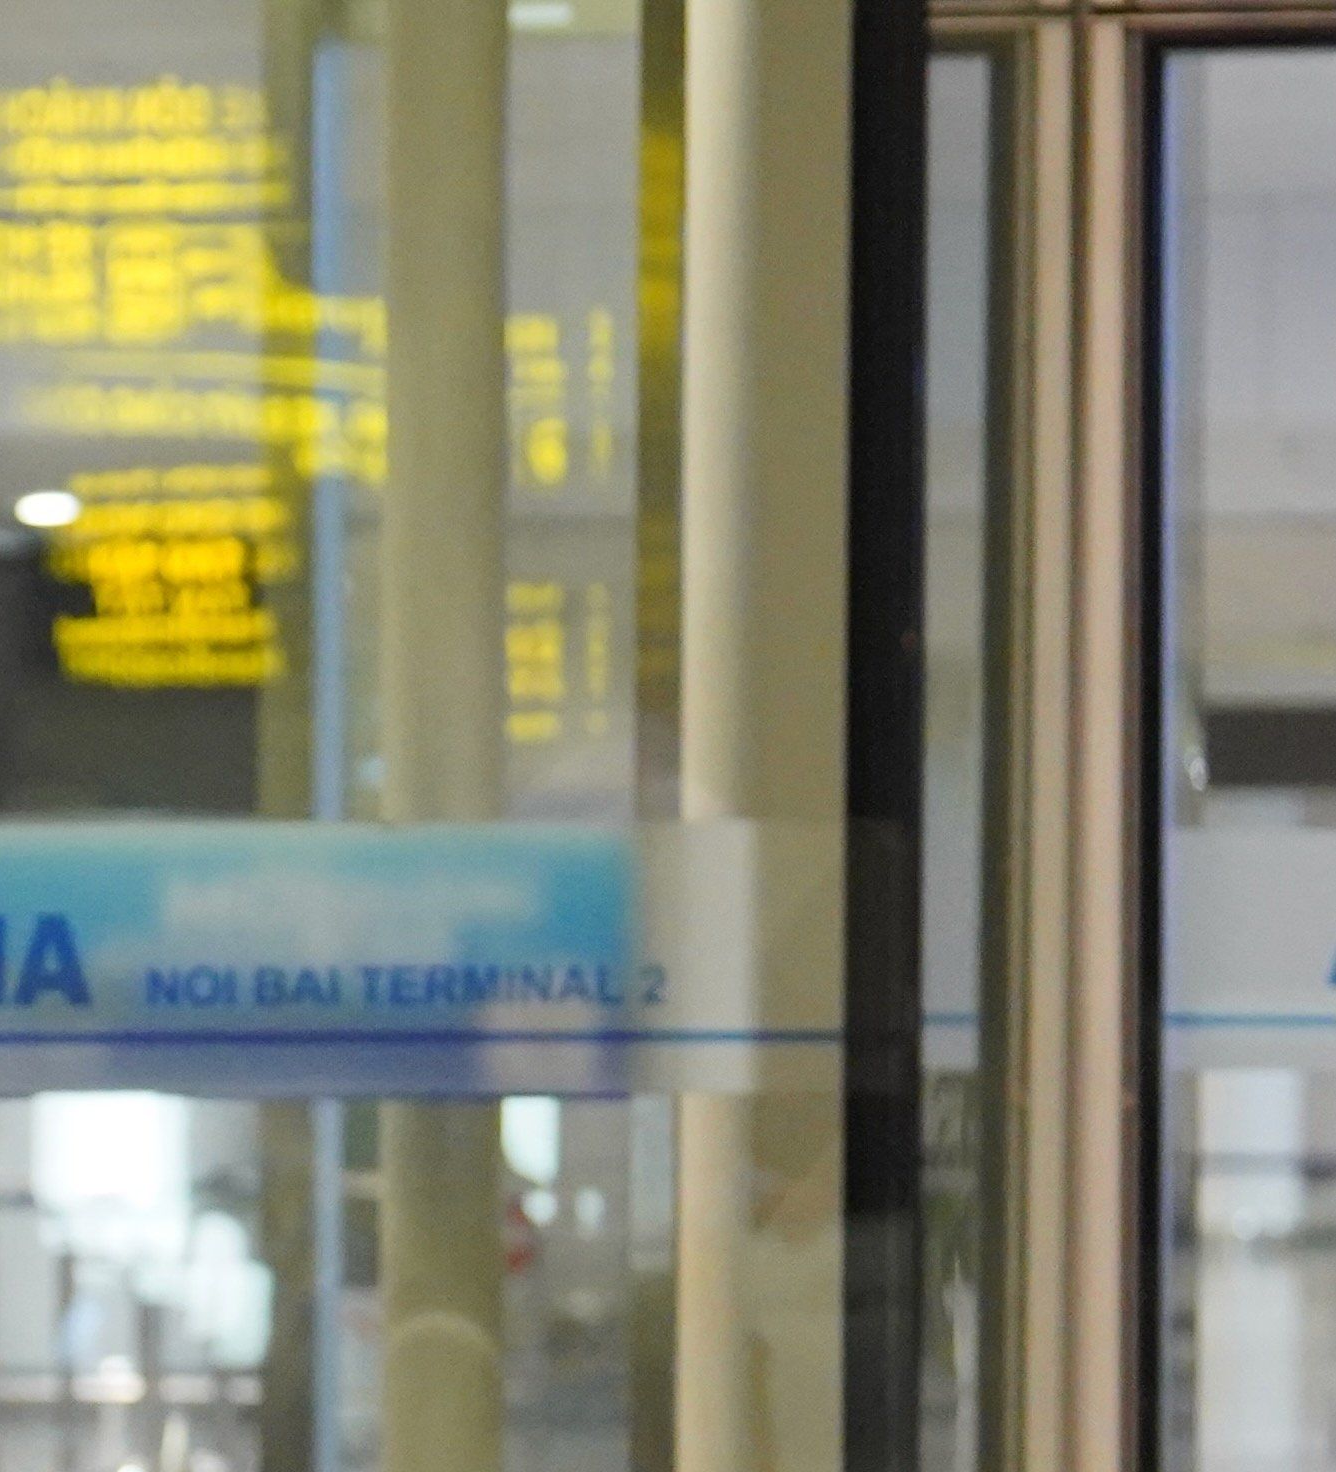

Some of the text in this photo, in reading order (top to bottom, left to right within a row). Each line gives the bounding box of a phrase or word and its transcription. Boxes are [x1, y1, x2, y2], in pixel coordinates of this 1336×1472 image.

[145, 964, 667, 1005] NOI BAI TERMINAL 2
